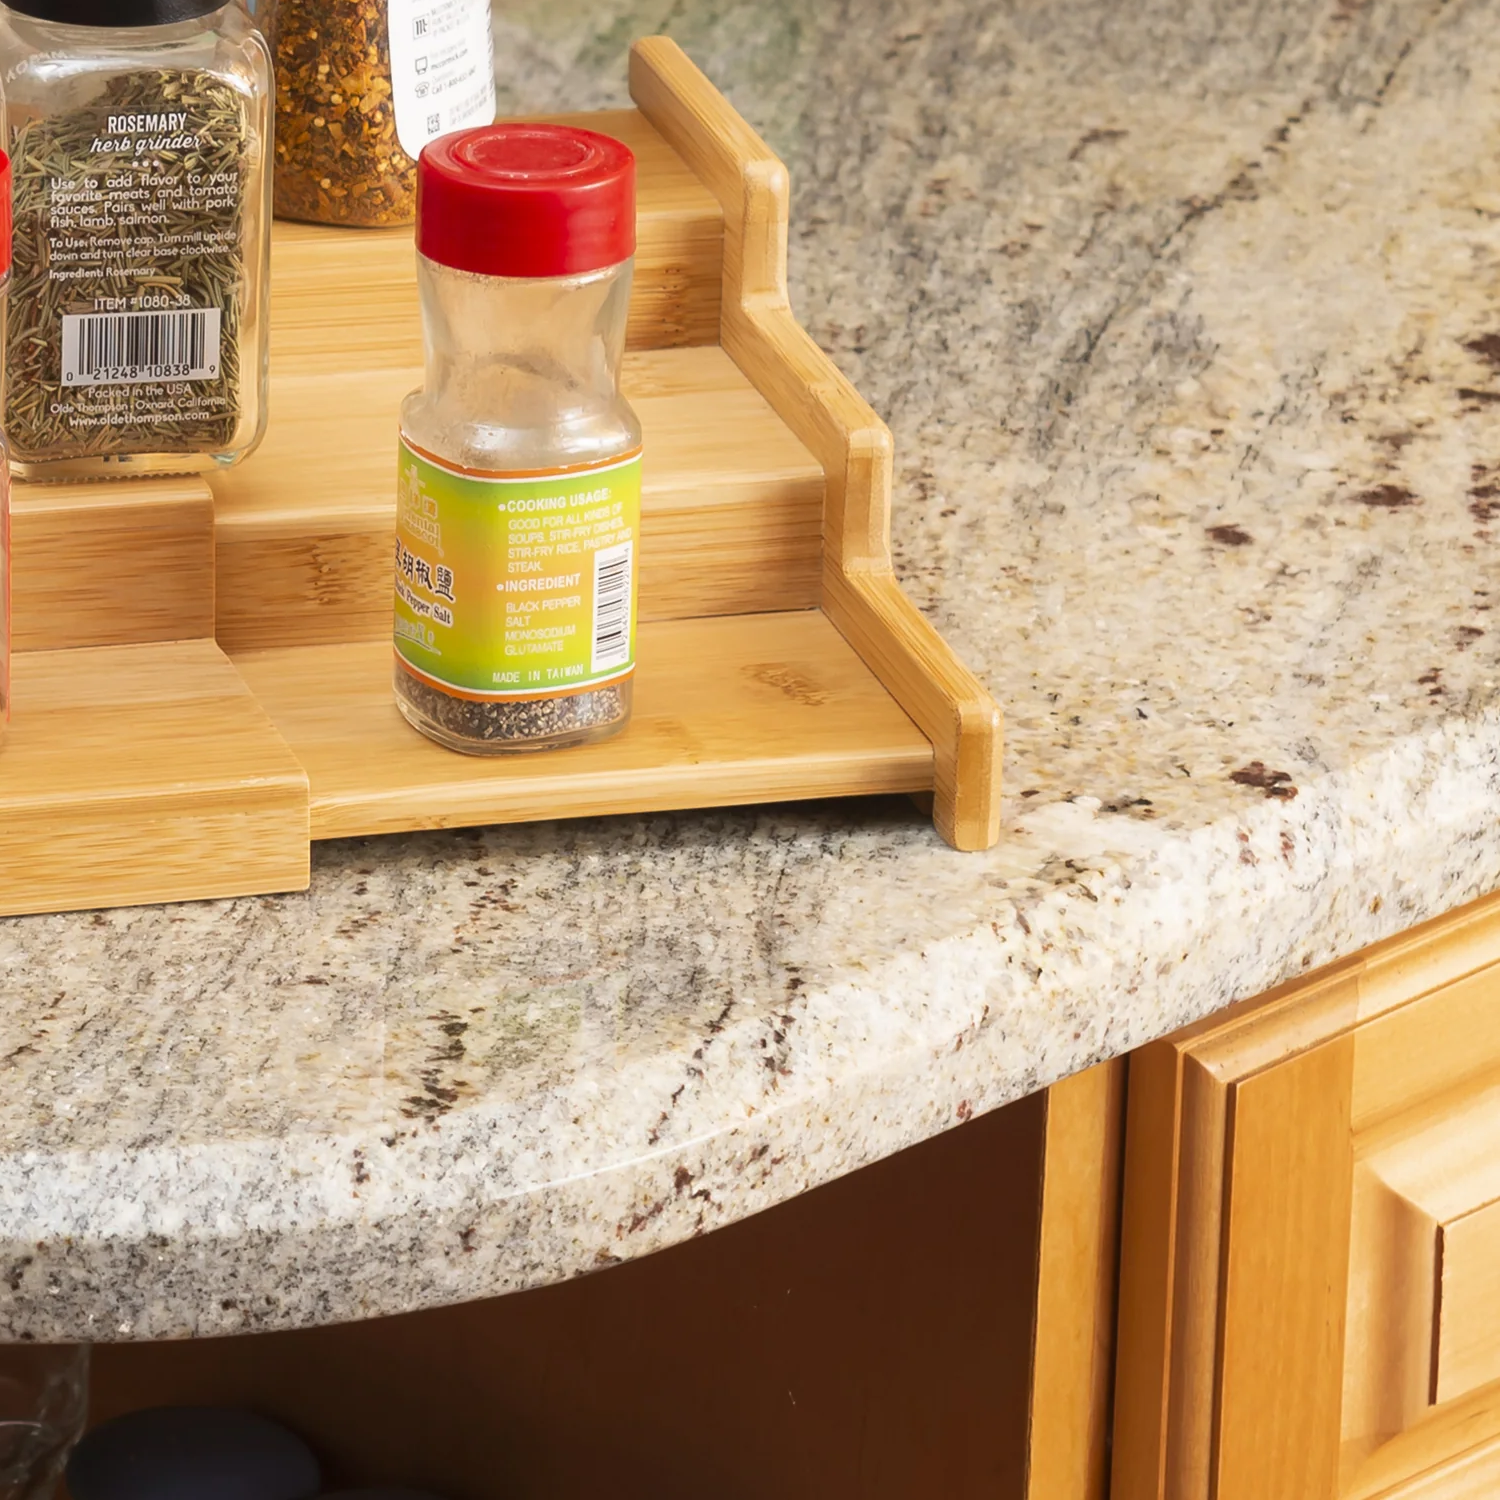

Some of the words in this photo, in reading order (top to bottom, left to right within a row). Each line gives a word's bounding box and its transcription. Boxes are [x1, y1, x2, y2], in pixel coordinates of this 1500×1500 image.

[107, 112, 187, 134] ROSEMARY
[90, 137, 131, 153] herb
[135, 134, 202, 156] grinder
[51, 177, 76, 190] Use
[85, 178, 98, 189] to
[106, 175, 132, 188] add
[141, 174, 178, 186] flavor
[187, 173, 200, 184] to
[209, 172, 238, 186] your
[50, 190, 102, 203] favorite
[109, 189, 150, 200] meats
[157, 186, 183, 198] and
[189, 184, 238, 196] tomato
[104, 201, 135, 213] Pairs
[141, 199, 166, 211] well
[172, 198, 200, 210] with
[119, 213, 170, 225] salmon.
[50, 238, 62, 248] To
[90, 235, 132, 247] Remove
[157, 233, 182, 244] Turn
[203, 230, 237, 244] upside
[50, 250, 78, 261] down
[80, 248, 100, 260] and
[102, 249, 124, 259] turn
[125, 246, 152, 258] clear
[153, 245, 178, 256] base
[105, 266, 156, 278] Rosemary
[94, 297, 127, 310] ITEM
[130, 294, 191, 309] #1080-38
[66, 372, 74, 381] 0
[93, 366, 138, 380] 21248
[146, 364, 190, 378] 10838
[209, 365, 216, 375] 9
[88, 386, 130, 399] Packed
[132, 386, 143, 397] in
[145, 385, 164, 397] the
[166, 383, 192, 395] USA
[50, 403, 75, 414] Olde
[77, 402, 128, 414] Thompson
[177, 397, 226, 408] California
[68, 411, 210, 427] www.oldethompson.com
[507, 495, 567, 513] COOKING
[570, 487, 612, 507] USAGE:
[508, 518, 540, 530] GOOD
[542, 515, 564, 528] FOR
[566, 512, 581, 525] ALL
[508, 546, 554, 559] STIR-FRY
[505, 573, 580, 592] INGREDIENT
[406, 588, 431, 615] Pepper
[433, 605, 451, 624] Salt
[506, 601, 540, 613] BLACK
[542, 595, 581, 611] PEPPER
[505, 615, 531, 627] SALT
[504, 624, 576, 641] MONOSODIUM
[504, 640, 564, 656] GLUTAMATE
[492, 671, 521, 683] MADE
[528, 670, 541, 681] IN
[546, 663, 584, 680] TAIWAN
